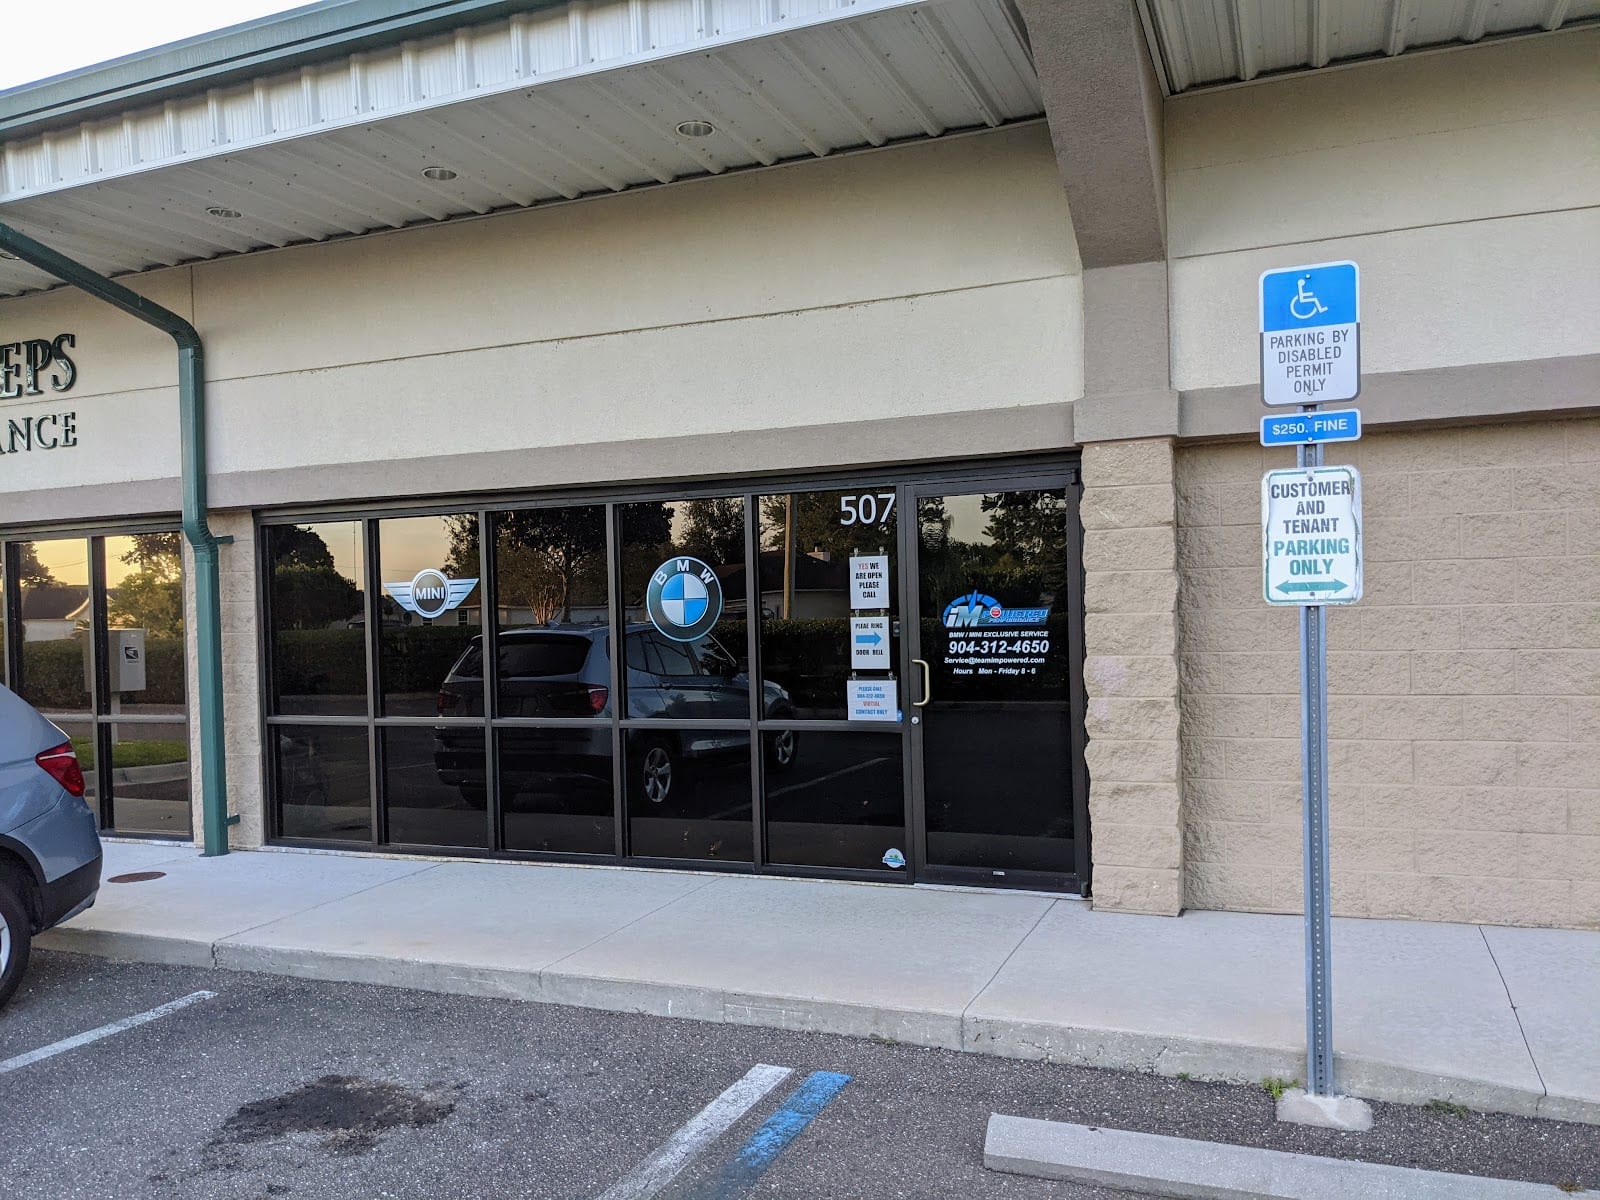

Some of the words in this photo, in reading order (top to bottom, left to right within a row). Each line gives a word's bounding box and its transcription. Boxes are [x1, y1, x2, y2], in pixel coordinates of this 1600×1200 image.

[1270, 331, 1325, 349] PARKING
[1332, 329, 1349, 343] BY
[1278, 346, 1342, 364] DISABLED
[1286, 362, 1334, 378] PERMIT
[1293, 378, 1326, 393] ONLY
[0, 411, 77, 455] NCE
[1272, 423, 1309, 436] $250.
[1314, 418, 1348, 432] FINE
[1270, 480, 1351, 499] CUSTOMER
[840, 493, 896, 526] 507
[1296, 500, 1325, 516] AND
[1283, 517, 1339, 534] TENANT
[1273, 538, 1350, 556] PARKING
[654, 559, 714, 586] BMW
[869, 562, 880, 570] WE
[1289, 558, 1334, 576] ONLY
[855, 572, 867, 580] ARE
[859, 581, 880, 589] PLEASE
[416, 587, 445, 600] MINI
[949, 640, 1050, 654] 904-312-4650
[944, 657, 1045, 665] Service@teamimpowered.com
[998, 667, 1020, 676] Friday
